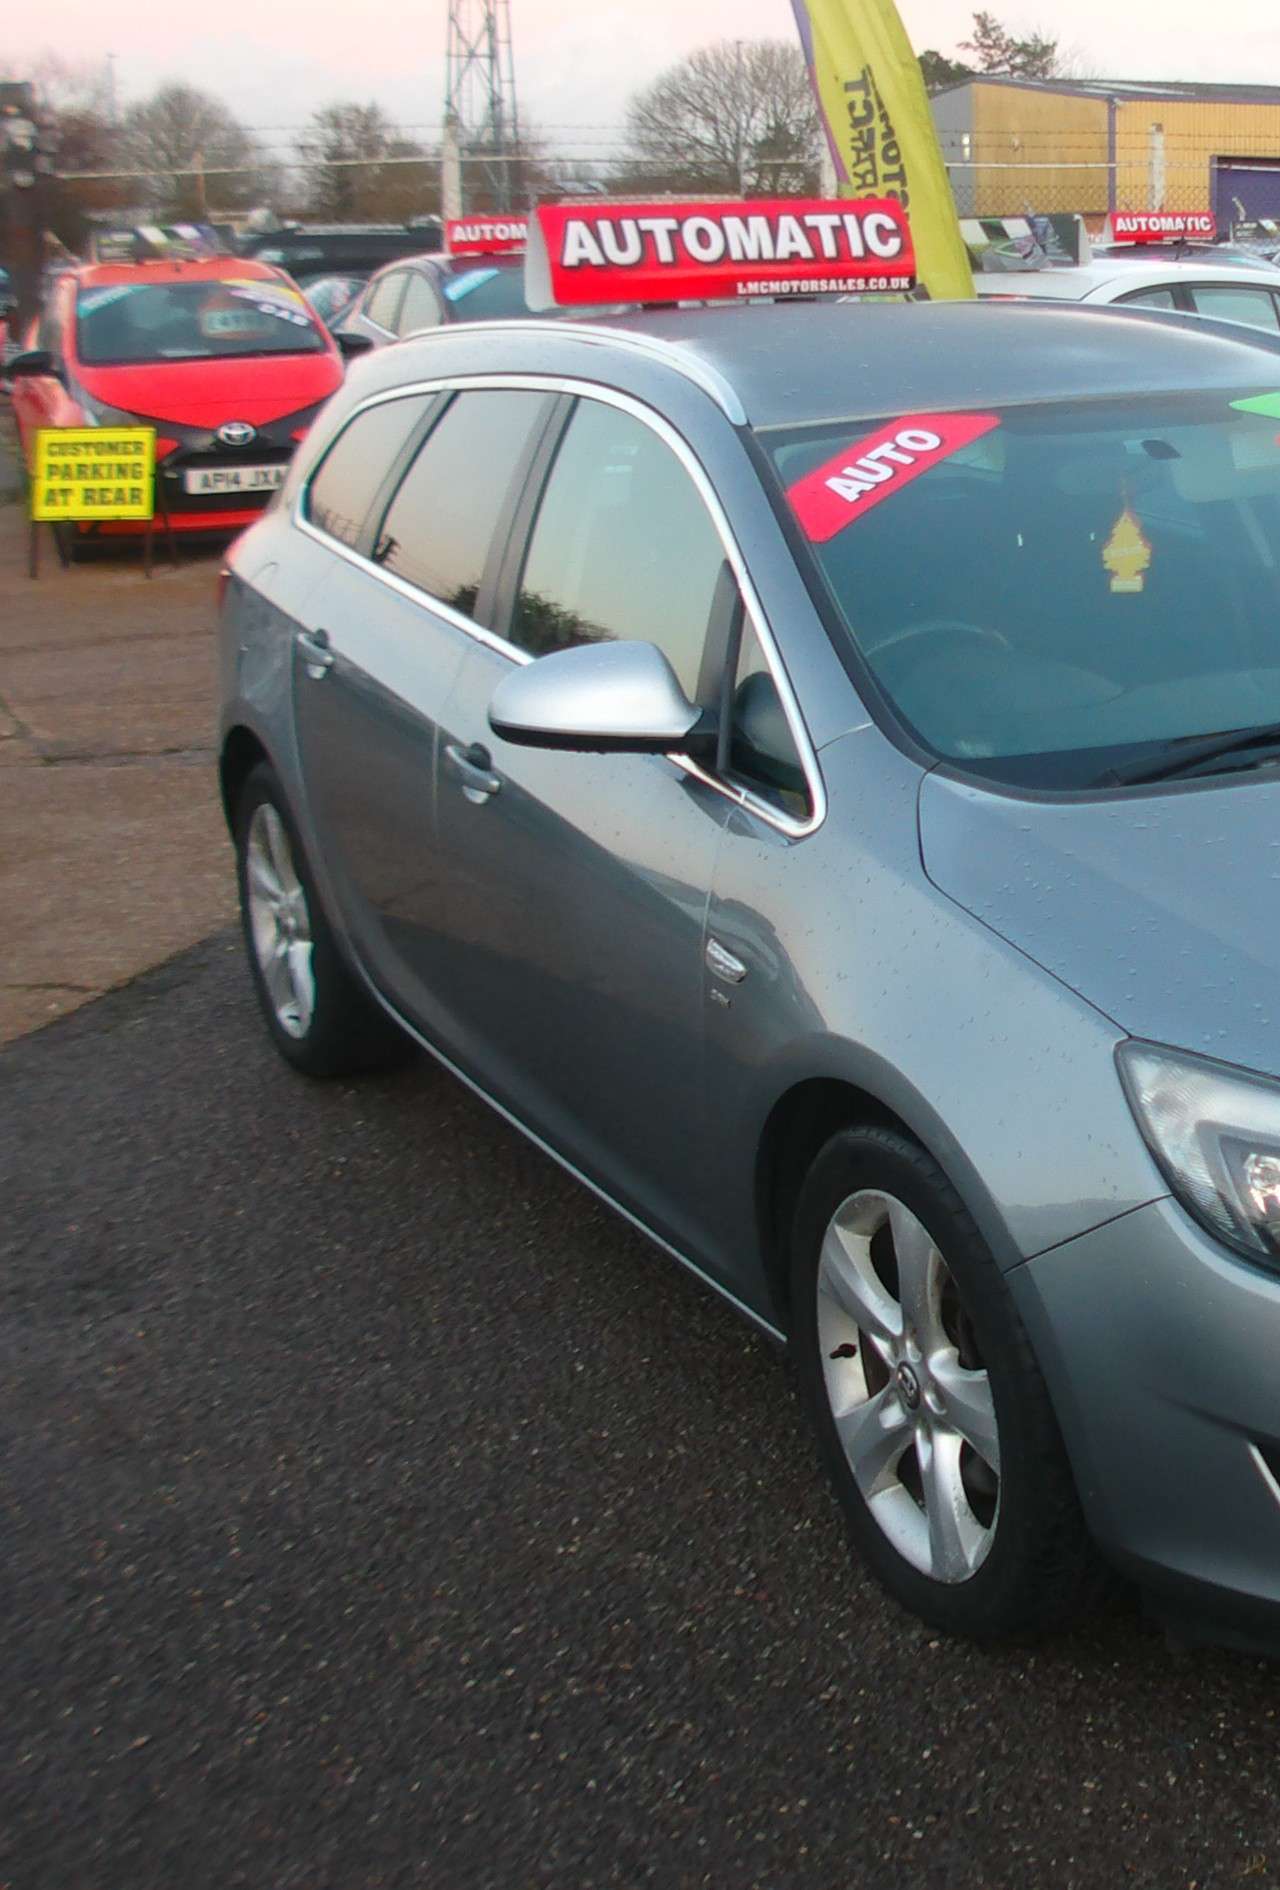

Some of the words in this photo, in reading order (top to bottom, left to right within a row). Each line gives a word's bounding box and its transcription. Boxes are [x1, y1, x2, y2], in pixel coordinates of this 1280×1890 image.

[1115, 215, 1212, 233] AUTOMATIC
[562, 213, 904, 268] AUTOMATIC
[737, 276, 911, 295] LMCMOTORSALES.CO.UK
[47, 441, 145, 457] CUSTOMER
[46, 462, 144, 481] PARKING
[824, 429, 942, 504] AUTO
[44, 488, 72, 506] AT
[82, 487, 144, 506] REAR
